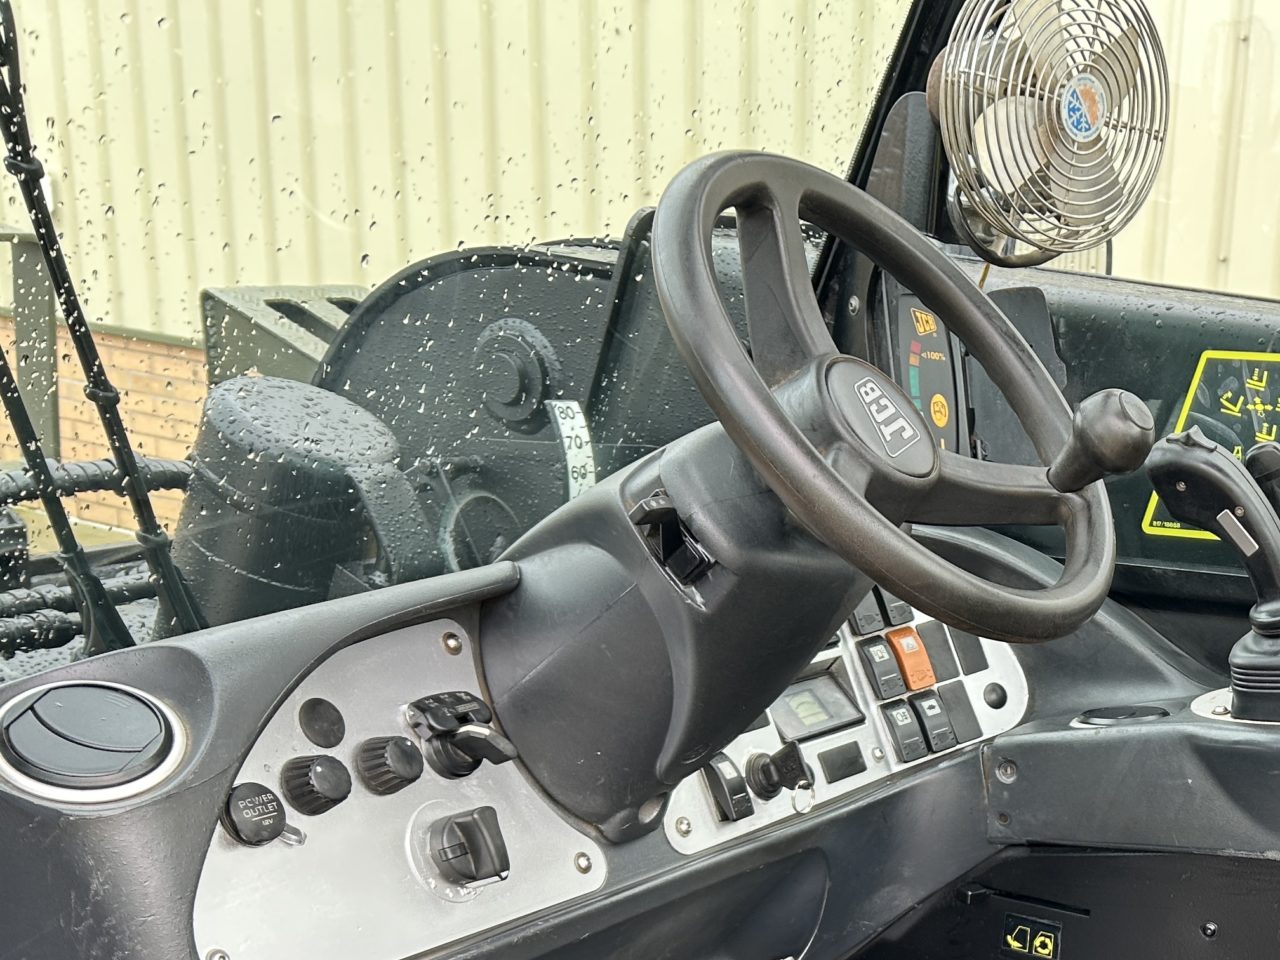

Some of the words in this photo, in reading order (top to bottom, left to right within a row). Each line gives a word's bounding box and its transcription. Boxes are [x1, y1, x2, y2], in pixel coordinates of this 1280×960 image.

[915, 311, 935, 333] JCB
[558, 405, 575, 420] 80
[859, 381, 914, 442] JCB
[564, 434, 583, 450] 70
[571, 465, 587, 480] 60
[238, 793, 274, 809] POWER
[243, 802, 277, 818] OUTLET
